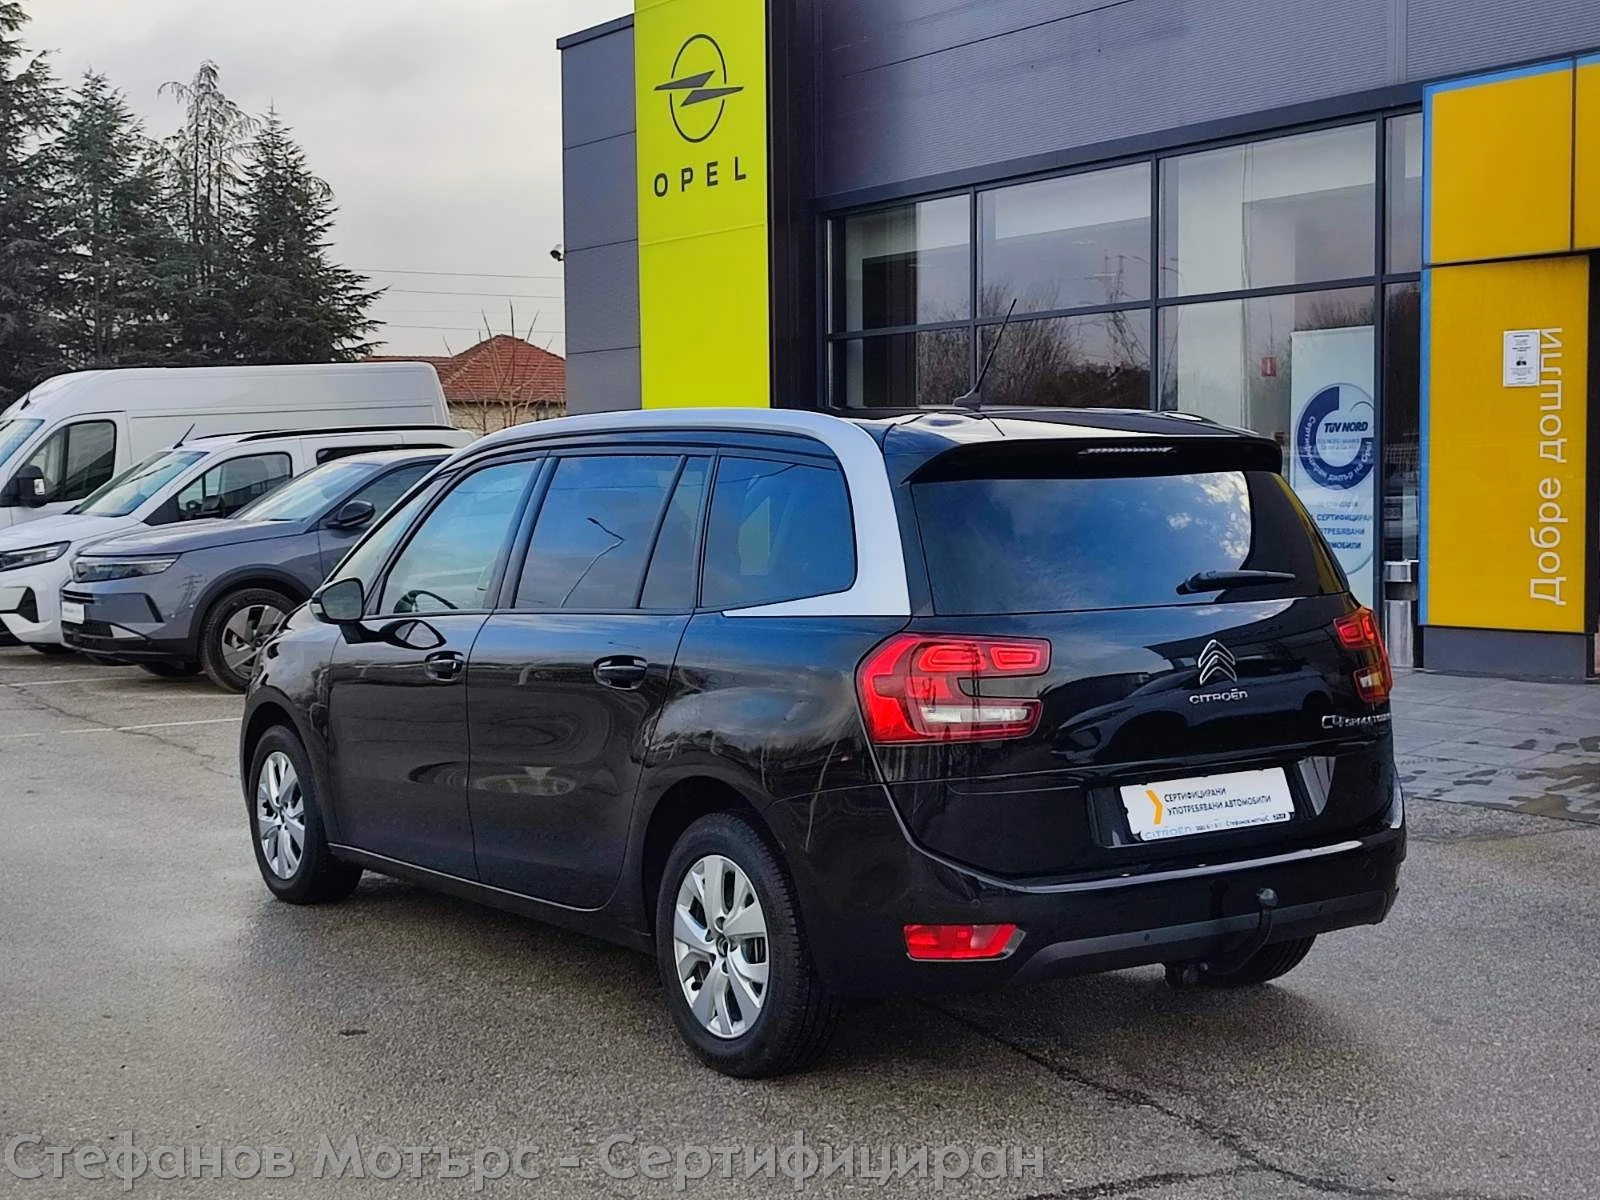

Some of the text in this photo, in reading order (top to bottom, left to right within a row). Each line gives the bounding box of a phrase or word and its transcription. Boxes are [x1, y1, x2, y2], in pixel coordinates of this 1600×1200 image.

[654, 156, 747, 197] OPEL
[1324, 421, 1369, 433] TÜV NORD
[1529, 327, 1568, 606] Добре дошли
[1321, 714, 1343, 728] C4
[1164, 787, 1227, 803] СЕРТИФИЦИРАНИ
[1167, 795, 1272, 816] УПОТРЕБЯВАНИ АВТОМОБИЛИ
